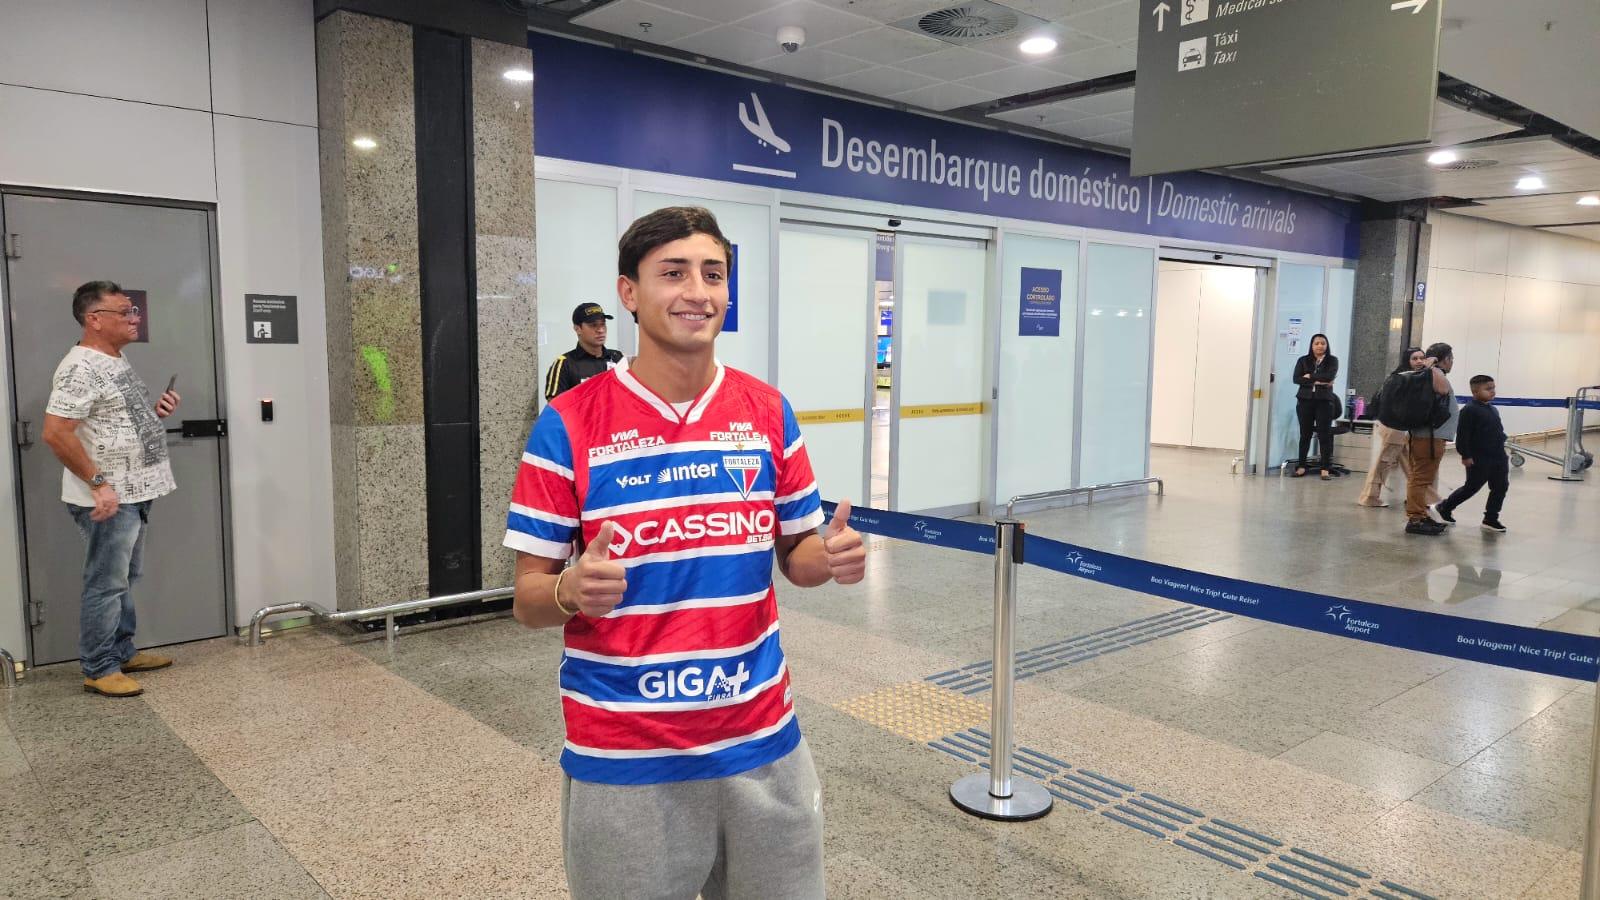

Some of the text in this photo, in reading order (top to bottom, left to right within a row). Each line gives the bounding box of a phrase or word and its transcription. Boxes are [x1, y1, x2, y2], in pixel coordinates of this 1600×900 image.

[1215, 0, 1266, 18] Medical
[1213, 29, 1239, 47] Táxi
[1213, 51, 1238, 65] Taxi
[821, 117, 1296, 235] Desembarque doméstico Domestic arrivals
[729, 421, 753, 431] VIVA
[611, 428, 639, 443] VIVA
[709, 431, 770, 444] FORTALEA
[588, 435, 666, 458] FORTALEZA
[724, 458, 760, 467] FORTALEZA
[634, 510, 775, 545] CASSINO
[1150, 576, 1260, 605] Boa Viagem! Nice Trip! Gute Reise!
[1344, 624, 1371, 635] Airport
[1346, 617, 1380, 629] Fortaleza
[1457, 634, 1475, 645] Boa
[1477, 638, 1516, 651] Viagem!
[1519, 645, 1541, 656] Nice
[1543, 648, 1566, 661] Trip!
[1569, 653, 1593, 664] Gute
